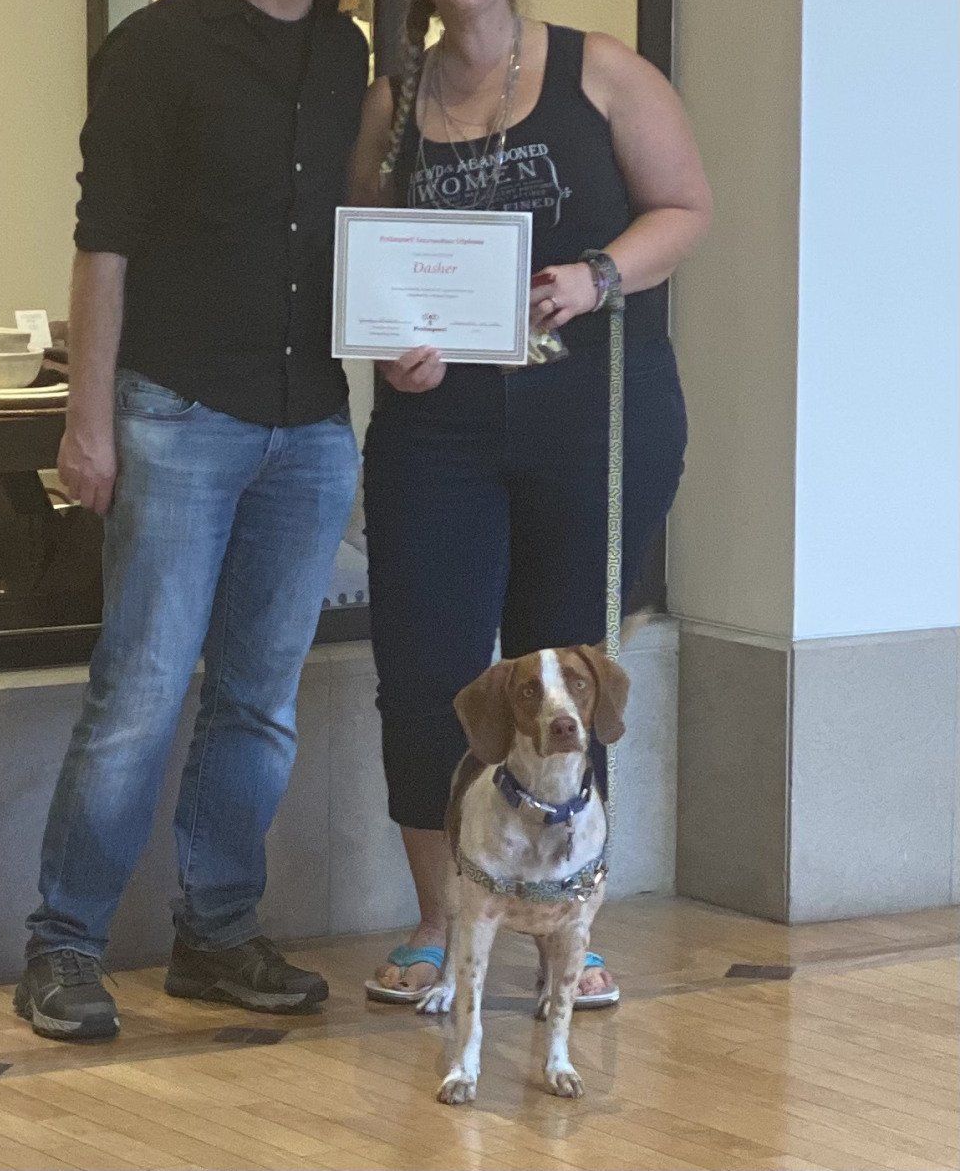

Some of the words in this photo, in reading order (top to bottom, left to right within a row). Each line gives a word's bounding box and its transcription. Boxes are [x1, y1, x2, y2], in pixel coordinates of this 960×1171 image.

[456, 143, 548, 174] ABANDONED
[417, 160, 537, 202] WOMEN
[413, 261, 457, 274] Dasher
